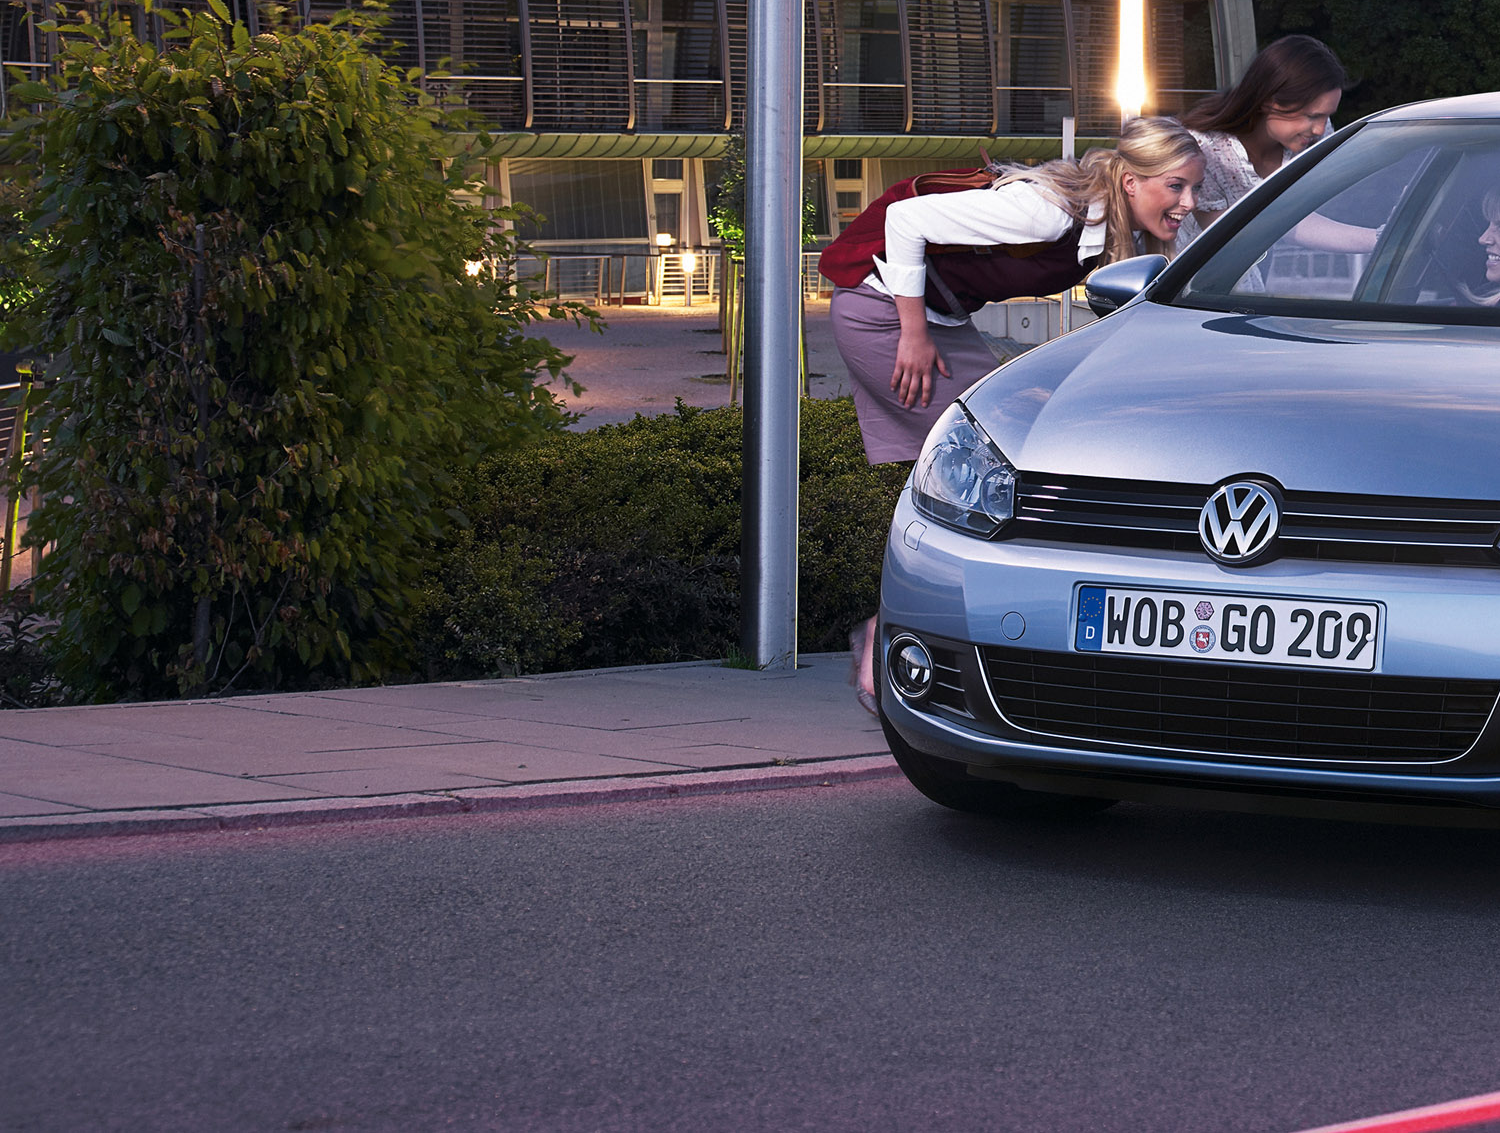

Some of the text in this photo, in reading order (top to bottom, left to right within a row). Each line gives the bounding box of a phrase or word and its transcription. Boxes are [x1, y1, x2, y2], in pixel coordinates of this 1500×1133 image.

[1200, 482, 1278, 558] VW
[1085, 626, 1096, 639] D
[1107, 596, 1186, 648] WOB
[1220, 603, 1276, 655] GO
[1287, 608, 1372, 661] 209
